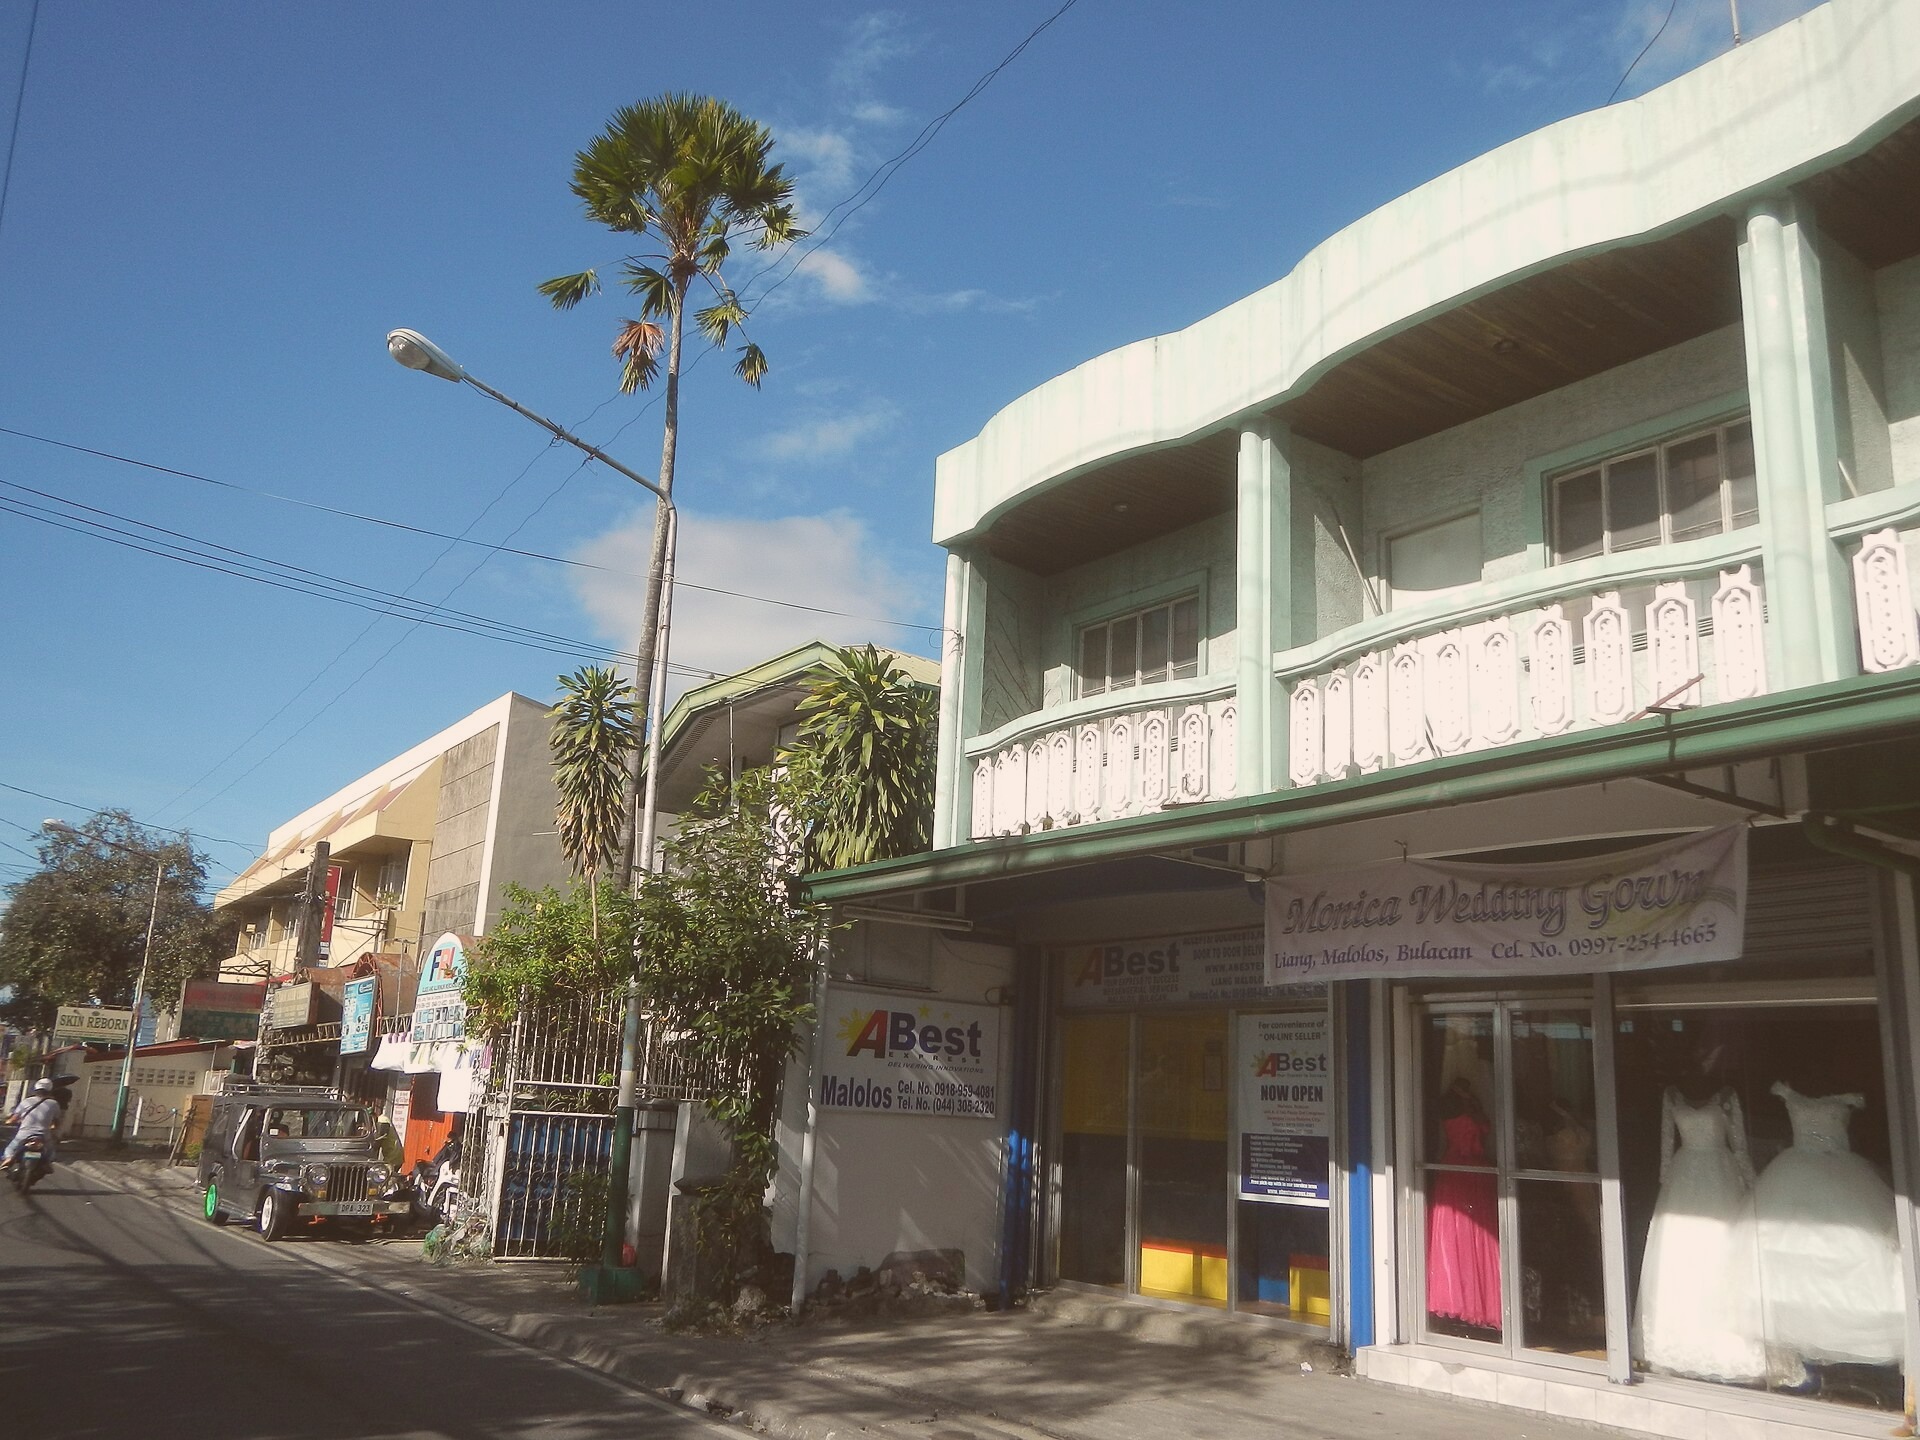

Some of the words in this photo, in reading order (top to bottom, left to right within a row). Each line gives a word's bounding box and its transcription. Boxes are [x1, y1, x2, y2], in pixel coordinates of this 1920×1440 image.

[1282, 889, 1402, 934] Monica
[1409, 878, 1569, 936] Wedding
[1243, 944, 1264, 956] DELIV
[1274, 953, 1316, 974] Liang,
[1321, 943, 1390, 965] Malolos,
[1395, 941, 1473, 962] Bulacan
[1490, 941, 1522, 959] Cel.
[1530, 941, 1563, 959] No.
[1568, 922, 1718, 957] 0997-254-4665
[1074, 942, 1181, 987] ABest
[1235, 975, 1264, 985] MALOLO
[60, 1014, 85, 1027] SKIN
[87, 1016, 129, 1030] REBORN
[1258, 1021, 1270, 1029] For
[1270, 1020, 1316, 1029] convenience
[1316, 1019, 1325, 1028] of
[846, 1009, 982, 1059] ABest
[887, 1061, 934, 1071] DELIVERING
[935, 1064, 985, 1074] INNOVATIONS
[889, 1053, 981, 1064] EXPRESS
[1255, 1052, 1327, 1077] ABest
[820, 1075, 892, 1109] Malolos
[897, 1080, 915, 1094] Cel.
[917, 1081, 932, 1096] No.
[934, 1082, 995, 1099] 0918-959-4081
[1261, 1085, 1289, 1101] NOW
[1292, 1085, 1323, 1102] OPEN
[897, 1096, 913, 1109] Tel.
[915, 1097, 930, 1111] No.
[933, 1098, 955, 1115] (044)
[957, 1099, 995, 1114] 305-2320
[357, 1204, 371, 1213] 323
